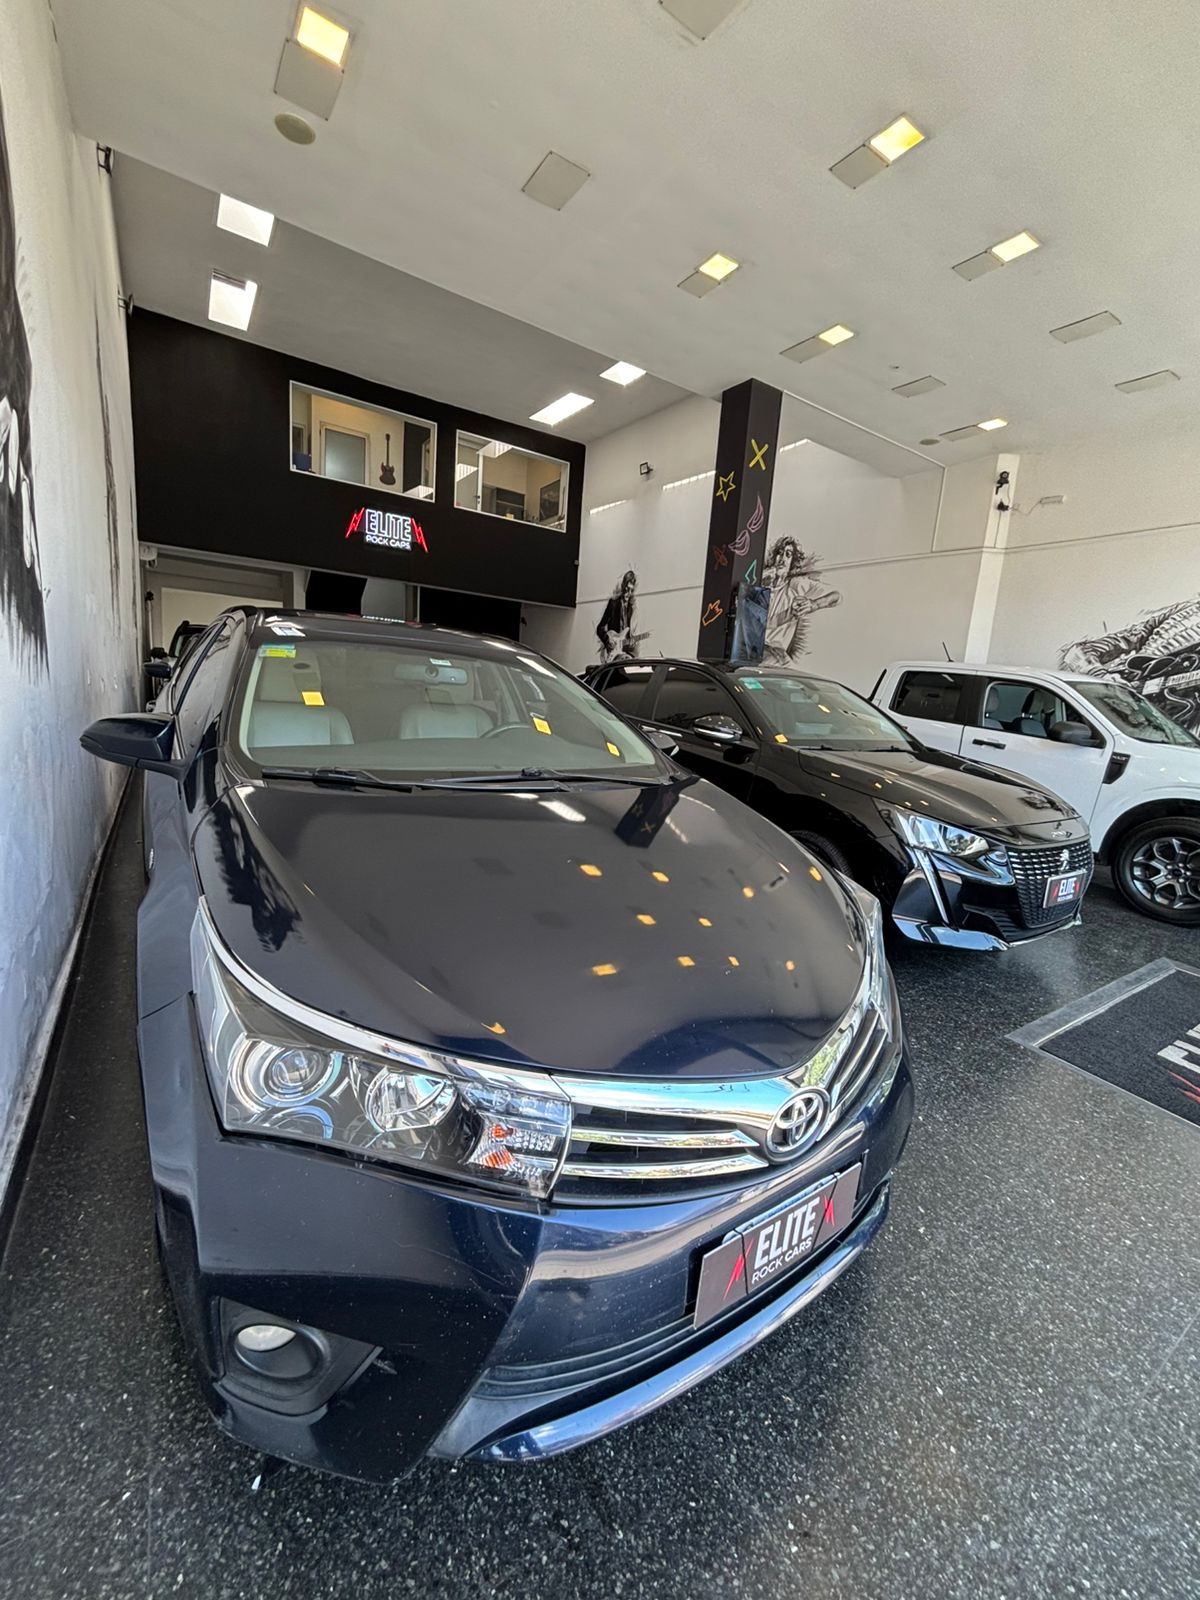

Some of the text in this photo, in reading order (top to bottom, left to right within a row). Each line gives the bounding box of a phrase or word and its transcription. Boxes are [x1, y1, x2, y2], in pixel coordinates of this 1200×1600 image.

[365, 508, 412, 542] ELITE
[753, 1196, 821, 1270] ELITE
[751, 1236, 813, 1284] ROCK CARS
